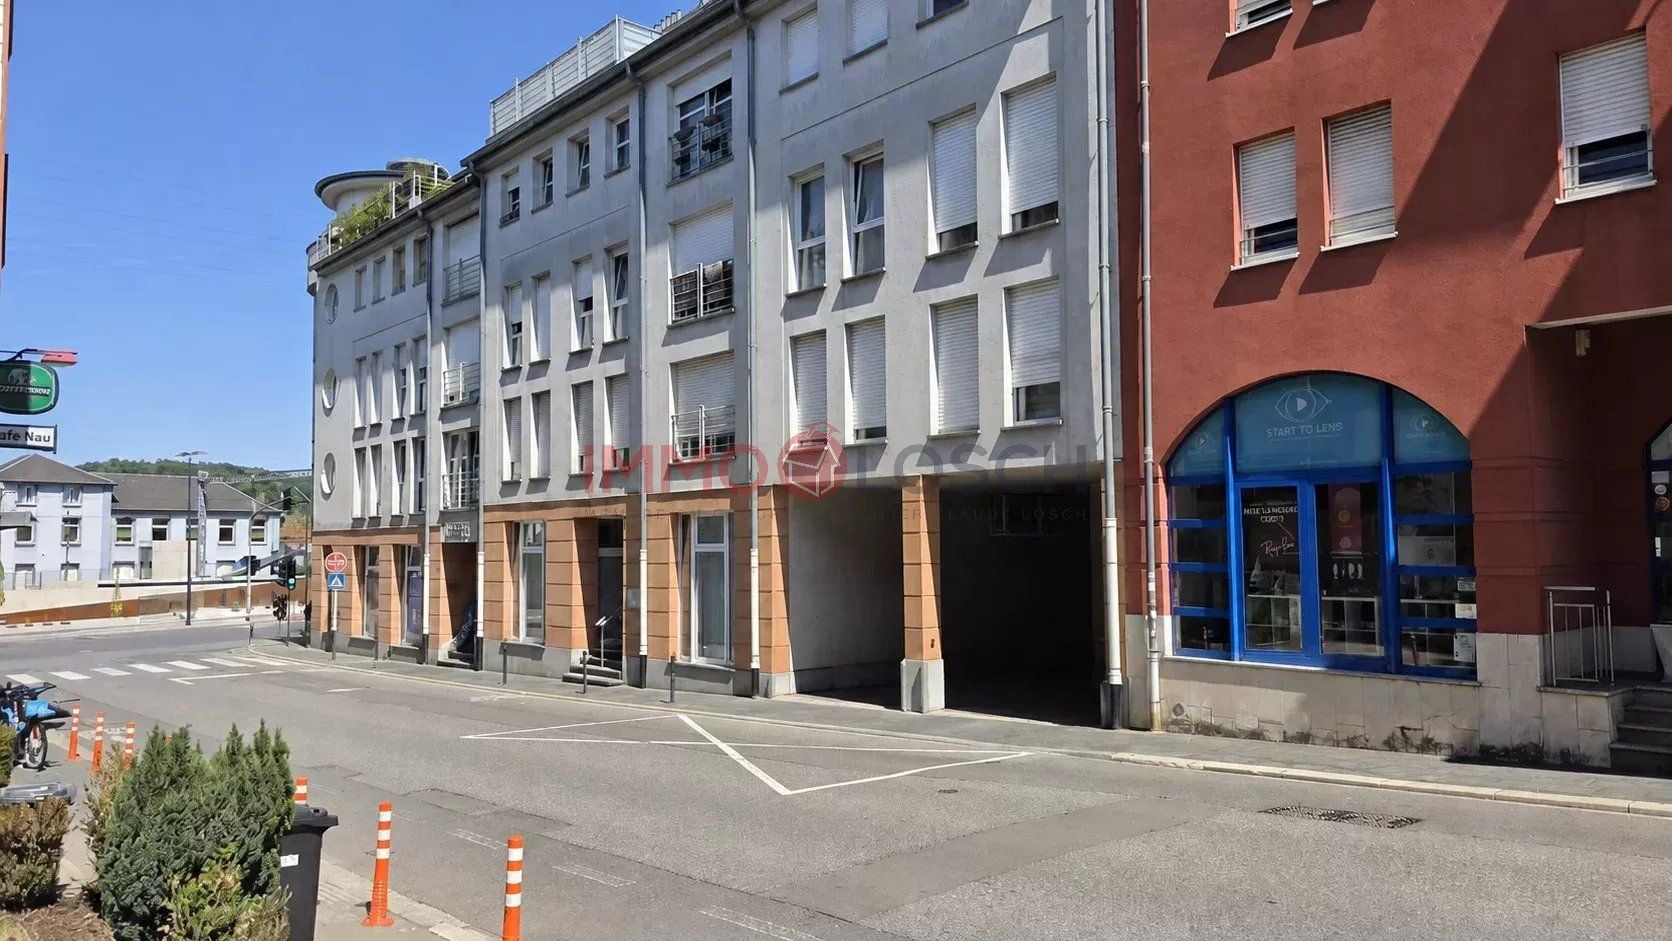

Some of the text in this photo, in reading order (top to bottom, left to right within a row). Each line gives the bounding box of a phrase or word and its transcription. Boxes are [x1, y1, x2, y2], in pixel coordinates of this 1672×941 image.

[25, 431, 51, 442] Nau
[1266, 422, 1344, 438] START TO LENS
